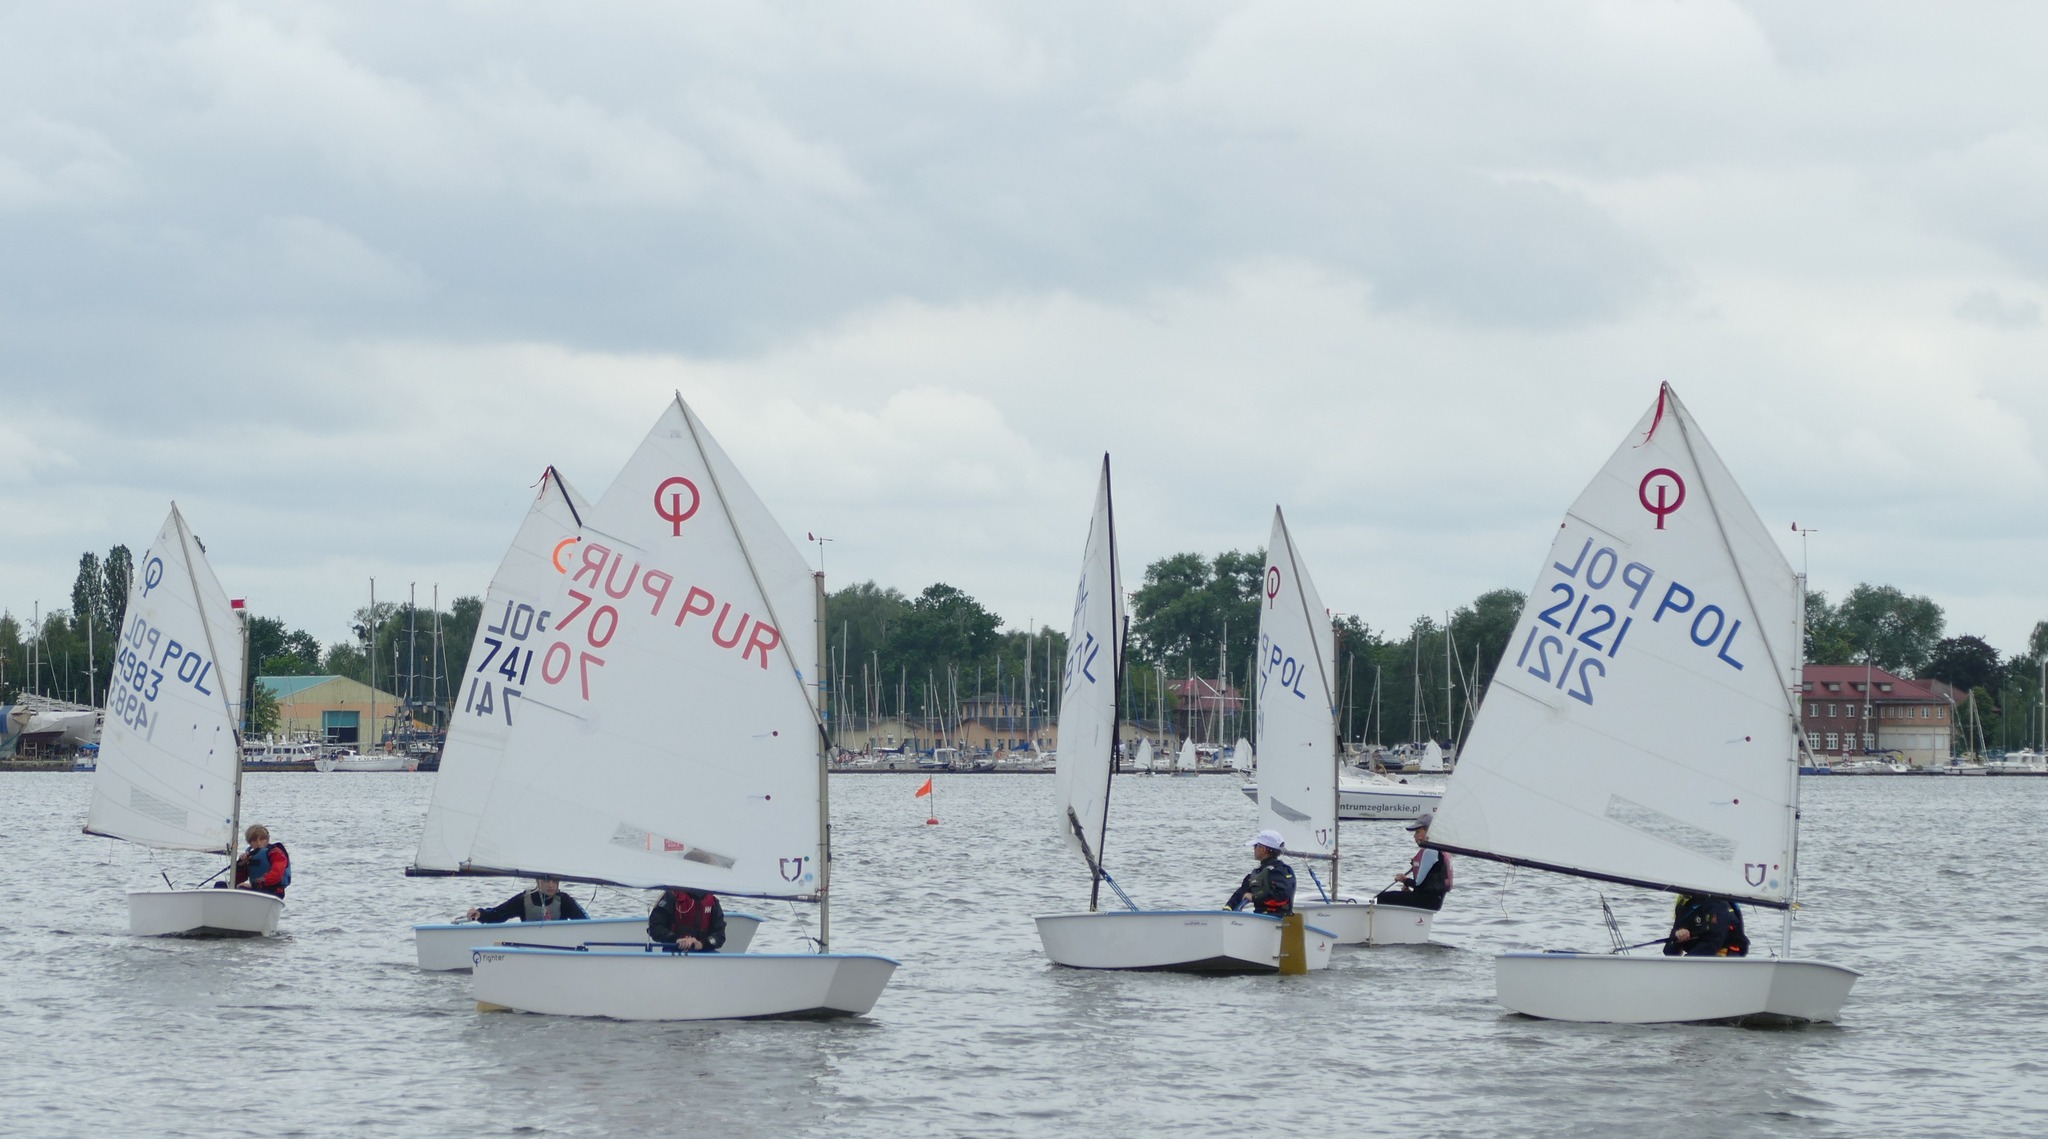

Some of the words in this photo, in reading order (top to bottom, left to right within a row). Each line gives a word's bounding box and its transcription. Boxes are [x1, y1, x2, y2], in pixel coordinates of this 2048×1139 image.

[555, 589, 618, 649] 70
[674, 585, 781, 670] PUR
[1537, 583, 1633, 658] 2121
[1652, 581, 1744, 671] POL
[160, 639, 212, 696] POL
[476, 637, 533, 685] 741
[1269, 644, 1306, 700] POL
[1339, 803, 1420, 814] ntrumzeglarskie.pl
